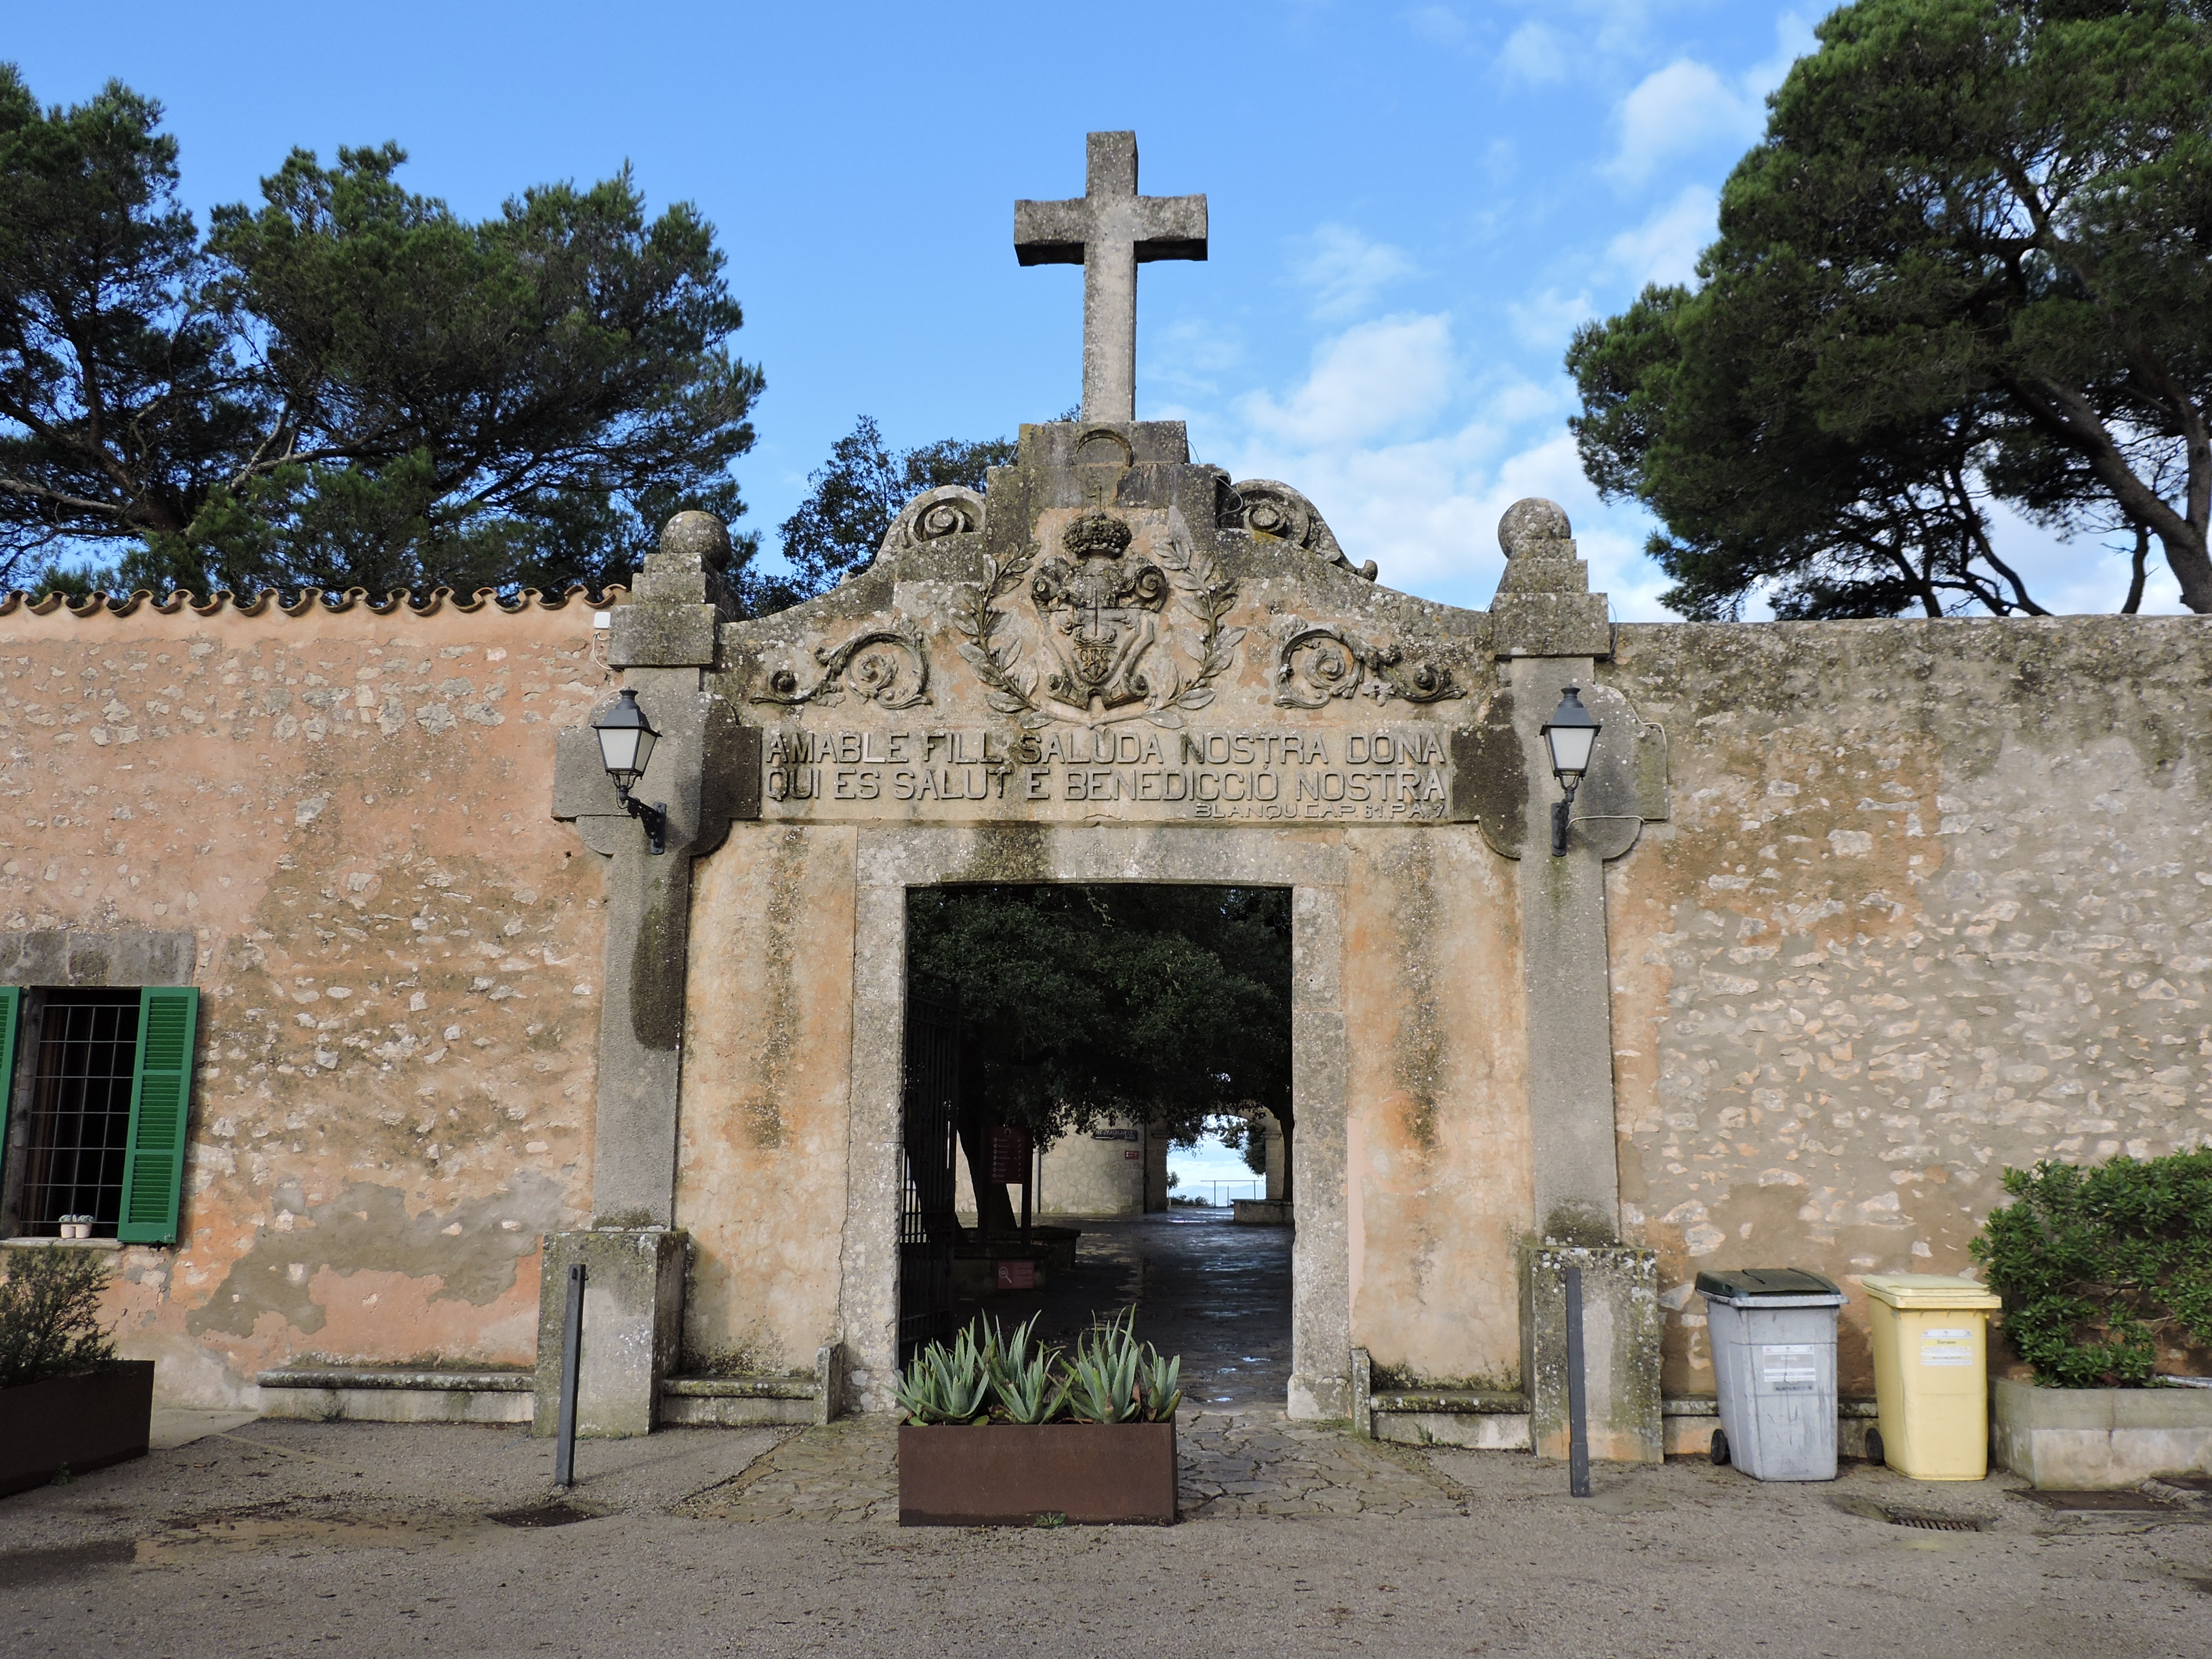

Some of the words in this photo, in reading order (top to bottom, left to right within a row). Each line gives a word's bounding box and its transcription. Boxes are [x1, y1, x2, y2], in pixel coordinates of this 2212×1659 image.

[765, 732, 909, 763] AMABLE
[924, 732, 1002, 763] FILL
[1017, 733, 1163, 764] SALUDA
[1180, 733, 1329, 764] NOSTRA
[1346, 732, 1446, 764] DONA
[766, 768, 821, 801] QUI
[834, 768, 880, 799] ES
[893, 766, 1011, 799] SALUT
[1025, 768, 1049, 799] E
[1295, 769, 1446, 801] NOSTRA
